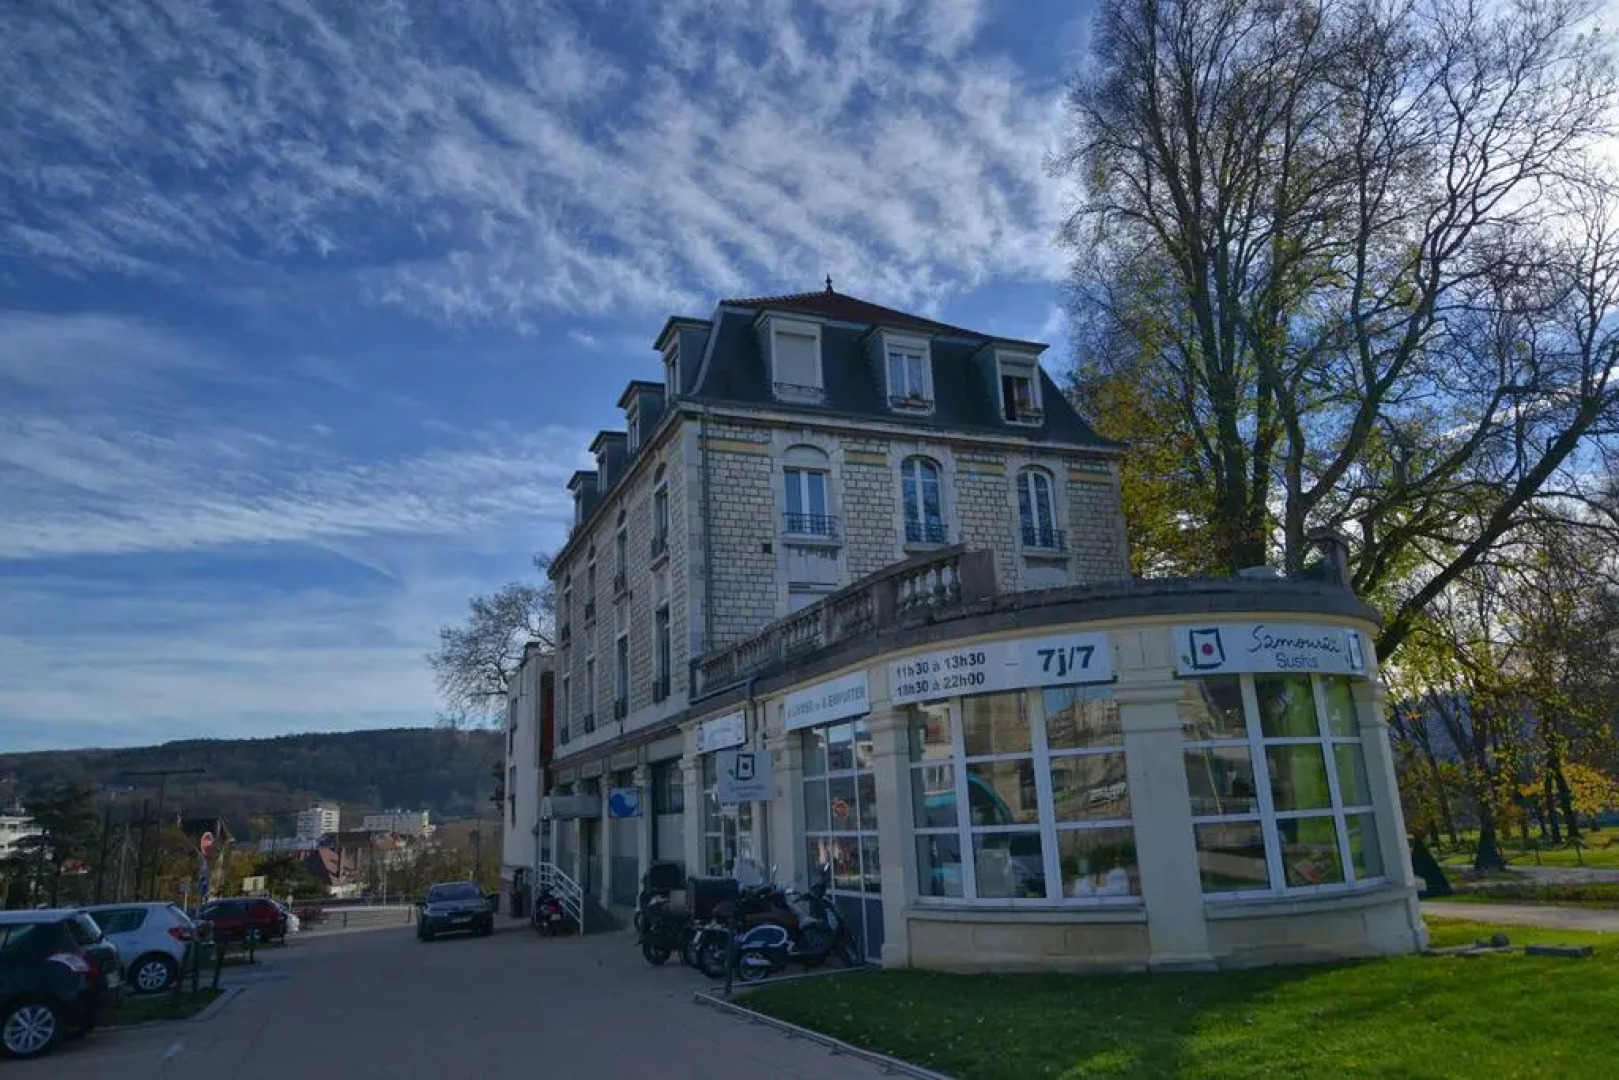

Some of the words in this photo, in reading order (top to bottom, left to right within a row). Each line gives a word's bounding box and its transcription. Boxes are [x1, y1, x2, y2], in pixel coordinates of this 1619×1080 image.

[896, 661, 928, 678] 11h30
[944, 652, 986, 669] 13h30
[1036, 644, 1095, 677] 7j/7
[897, 680, 928, 697] 18h30
[943, 672, 986, 689] 22h00
